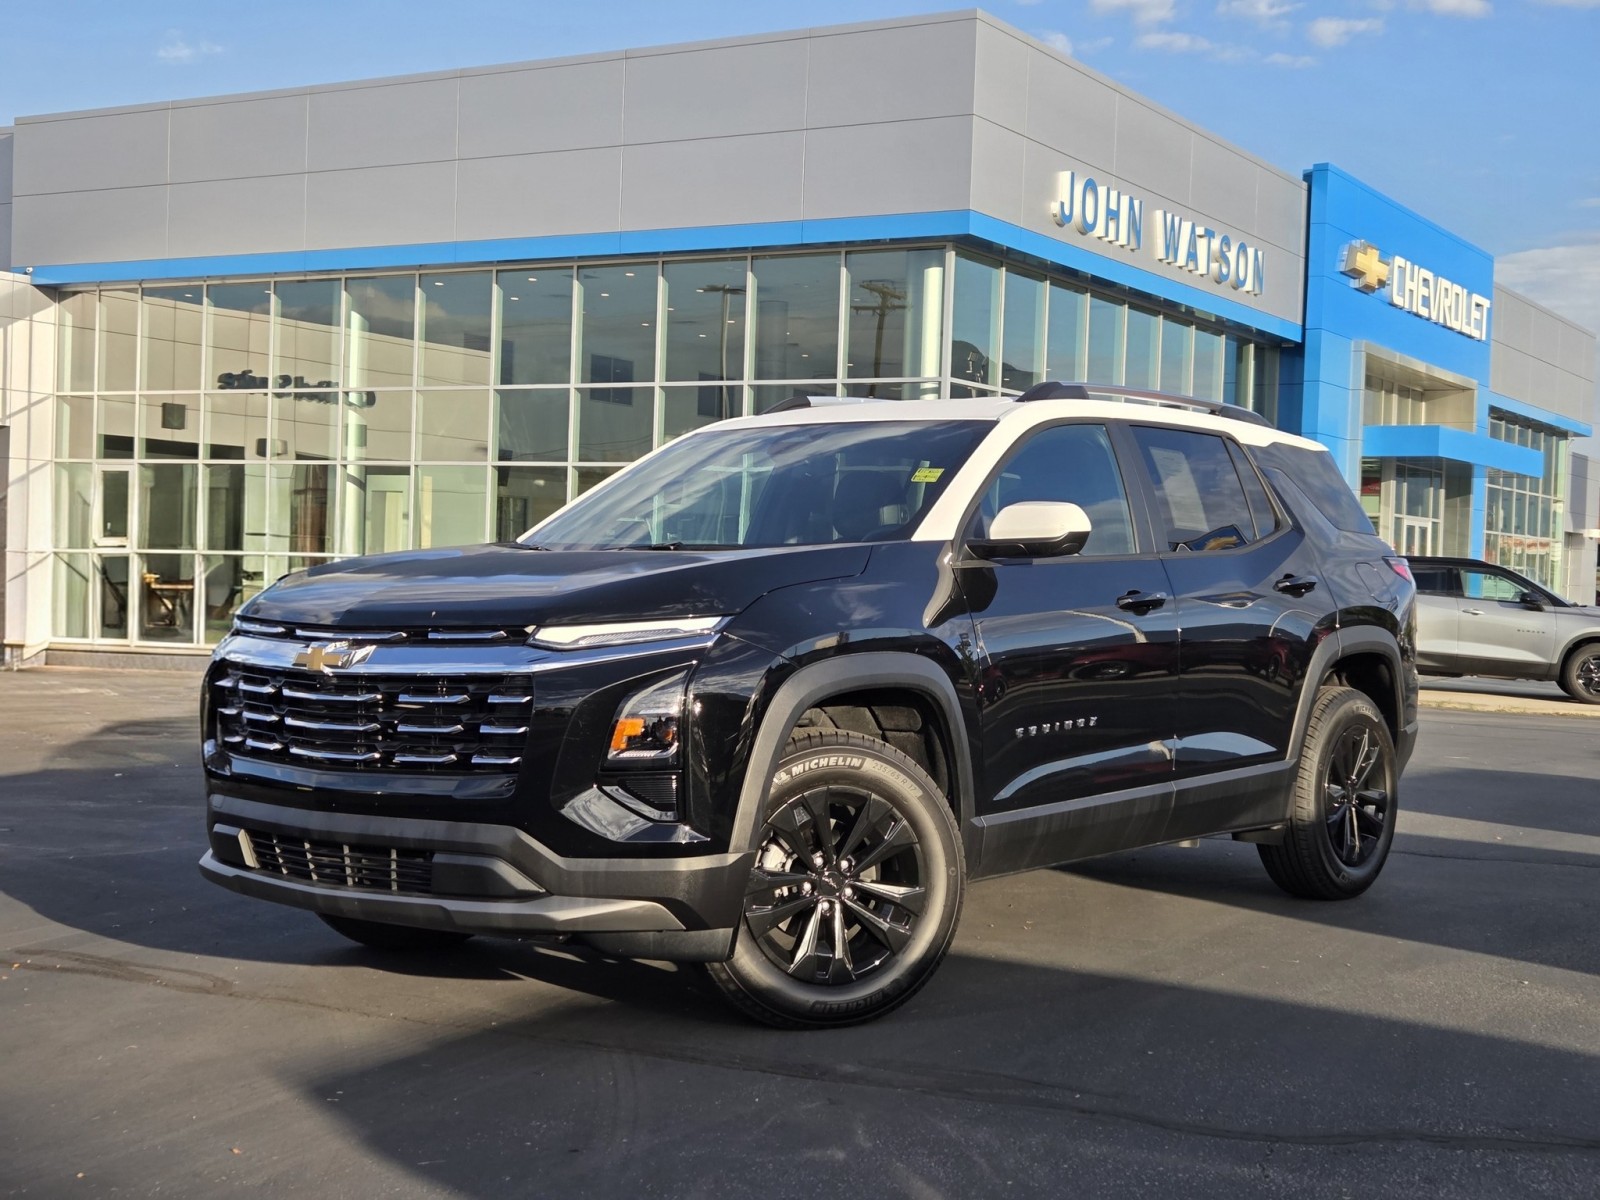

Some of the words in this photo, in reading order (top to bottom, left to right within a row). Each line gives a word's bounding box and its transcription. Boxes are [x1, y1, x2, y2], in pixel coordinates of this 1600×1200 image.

[1051, 170, 1143, 251] JOHN
[1154, 209, 1265, 296] WATSON
[1392, 255, 1491, 341] CHEVROLET
[791, 756, 863, 777] MICHELIN
